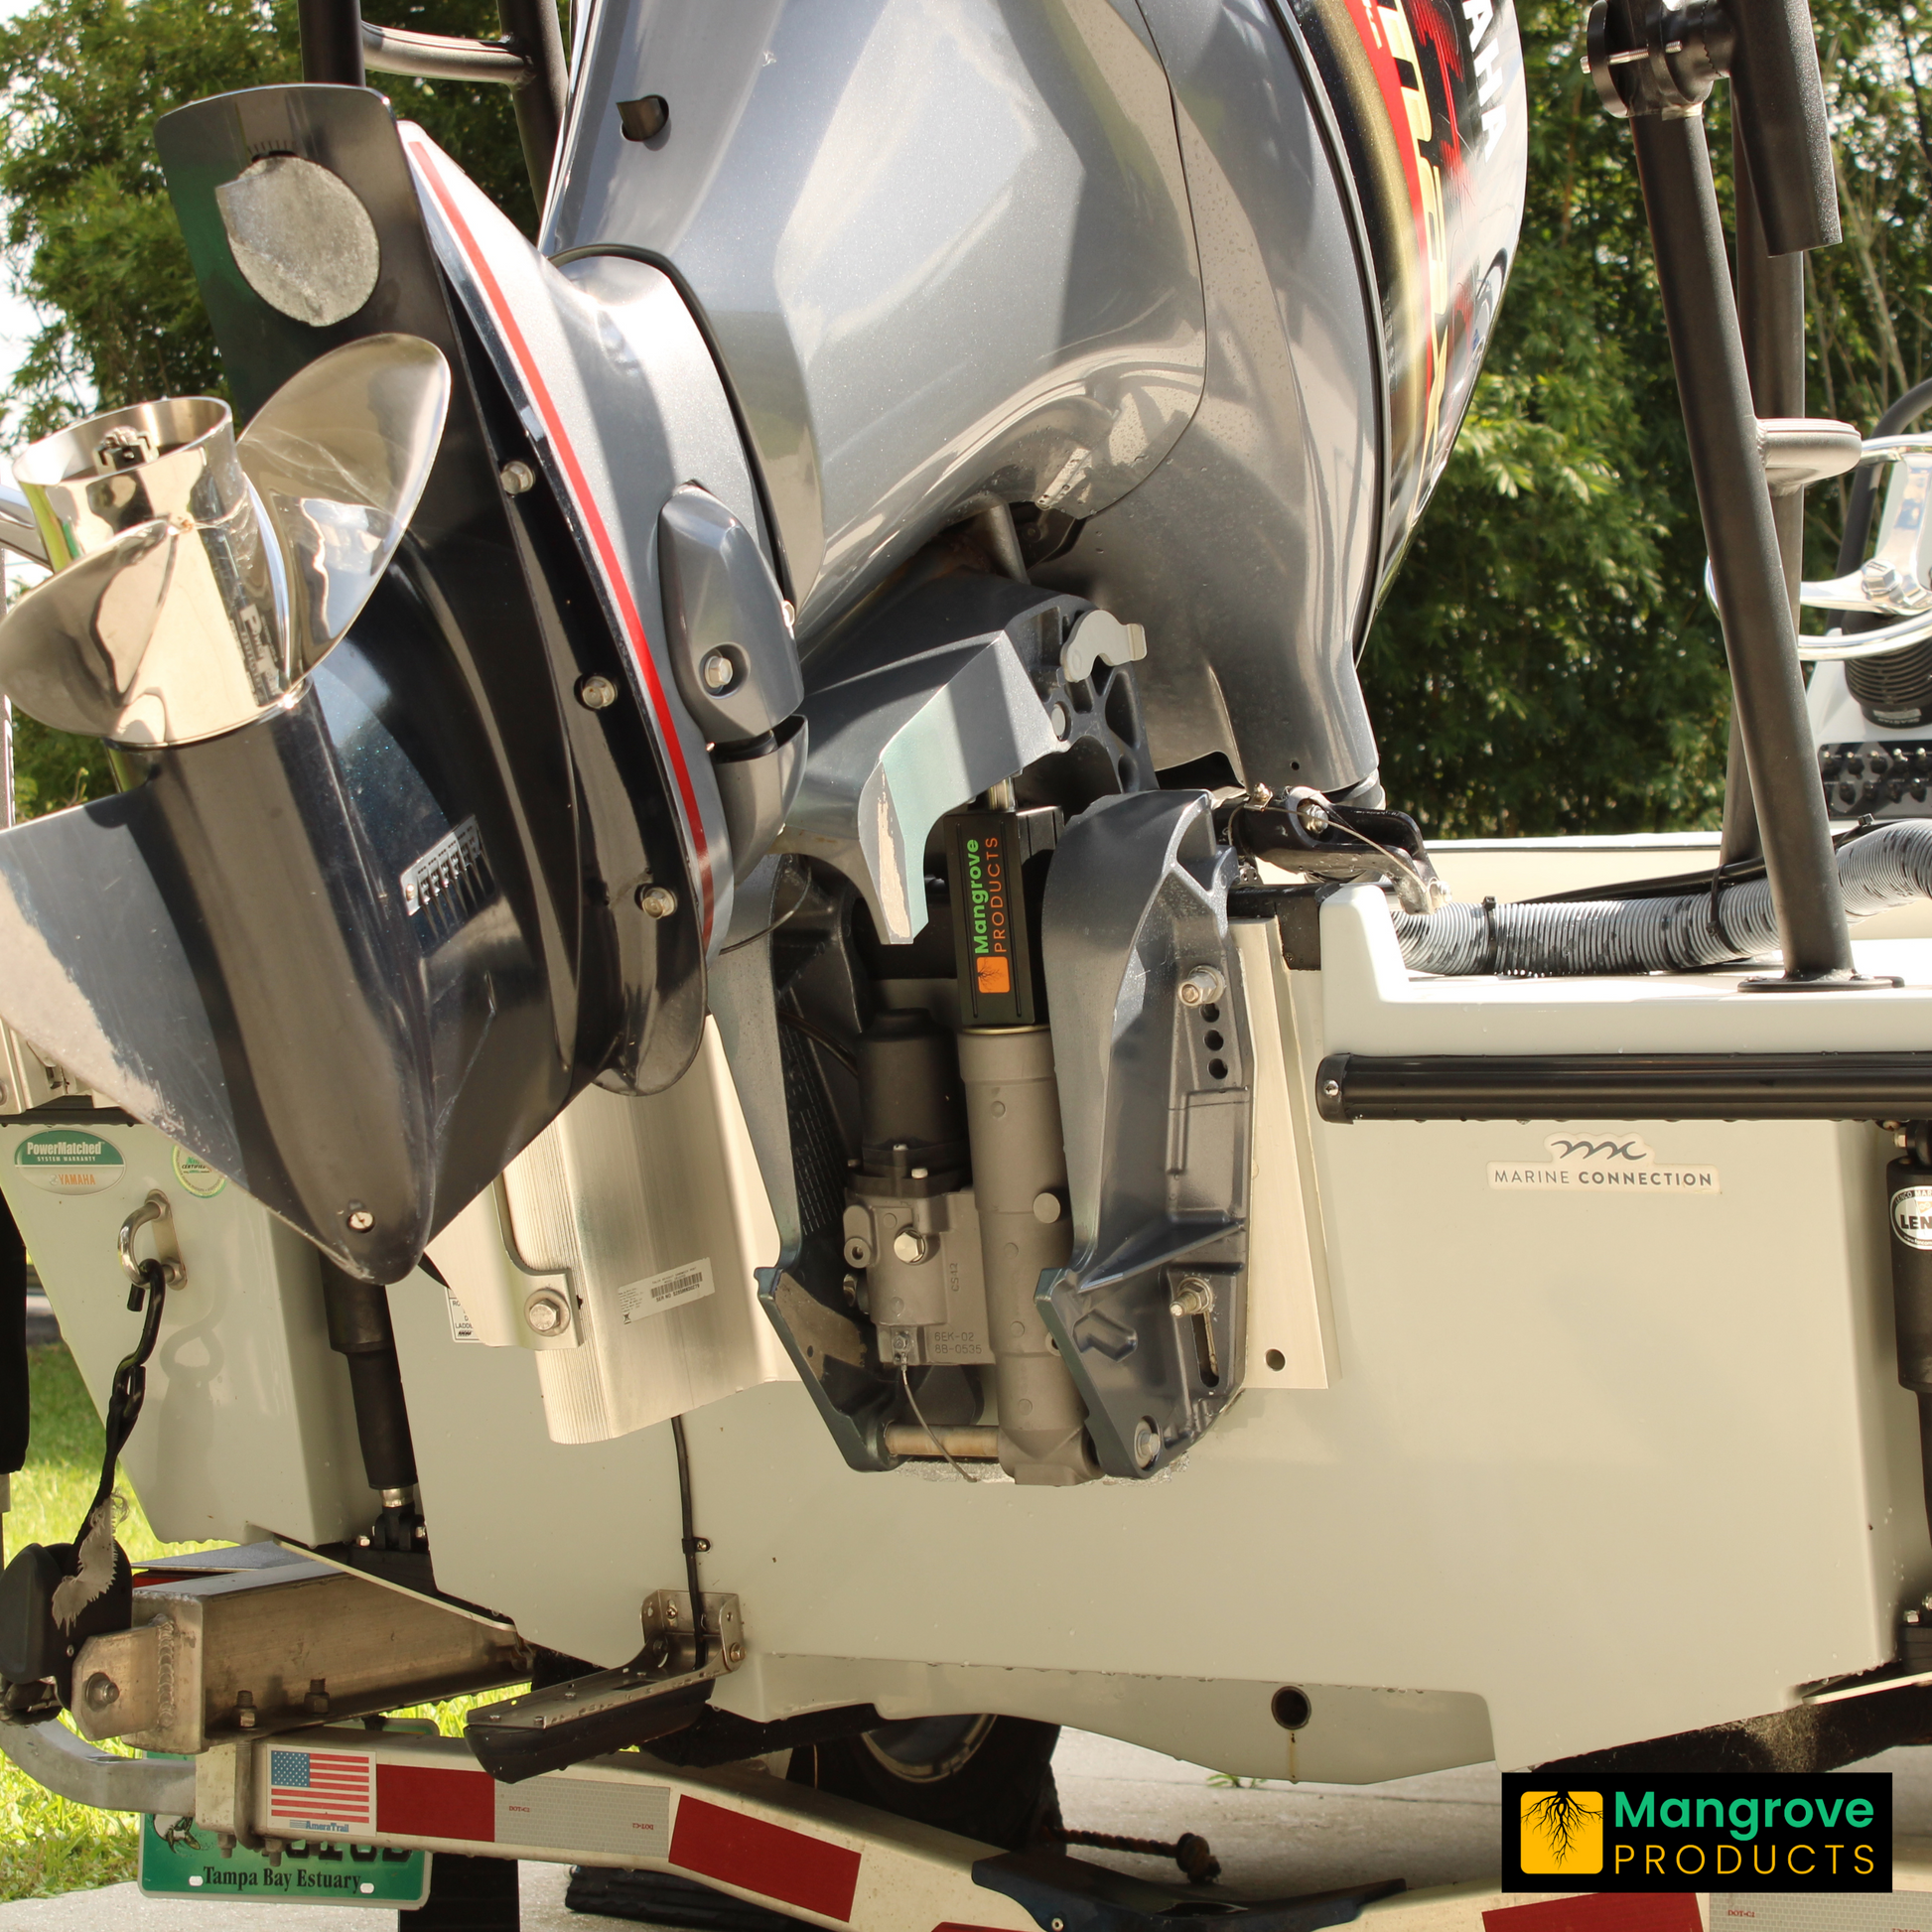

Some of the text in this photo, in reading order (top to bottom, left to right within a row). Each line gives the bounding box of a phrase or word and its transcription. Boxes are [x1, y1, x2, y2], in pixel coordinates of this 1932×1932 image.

[967, 839, 990, 954] Mangrove
[985, 837, 1008, 953] PRODUCTS
[59, 1173, 96, 1185] YAMAHA
[1494, 1169, 1713, 1186] MARINE CONNECTION
[934, 1331, 975, 1341] 6EK-02
[934, 1343, 983, 1354] 8B-0535
[305, 1820, 349, 1834] AmeraTrail
[203, 1865, 361, 1894] Tampa Bay Estuary
